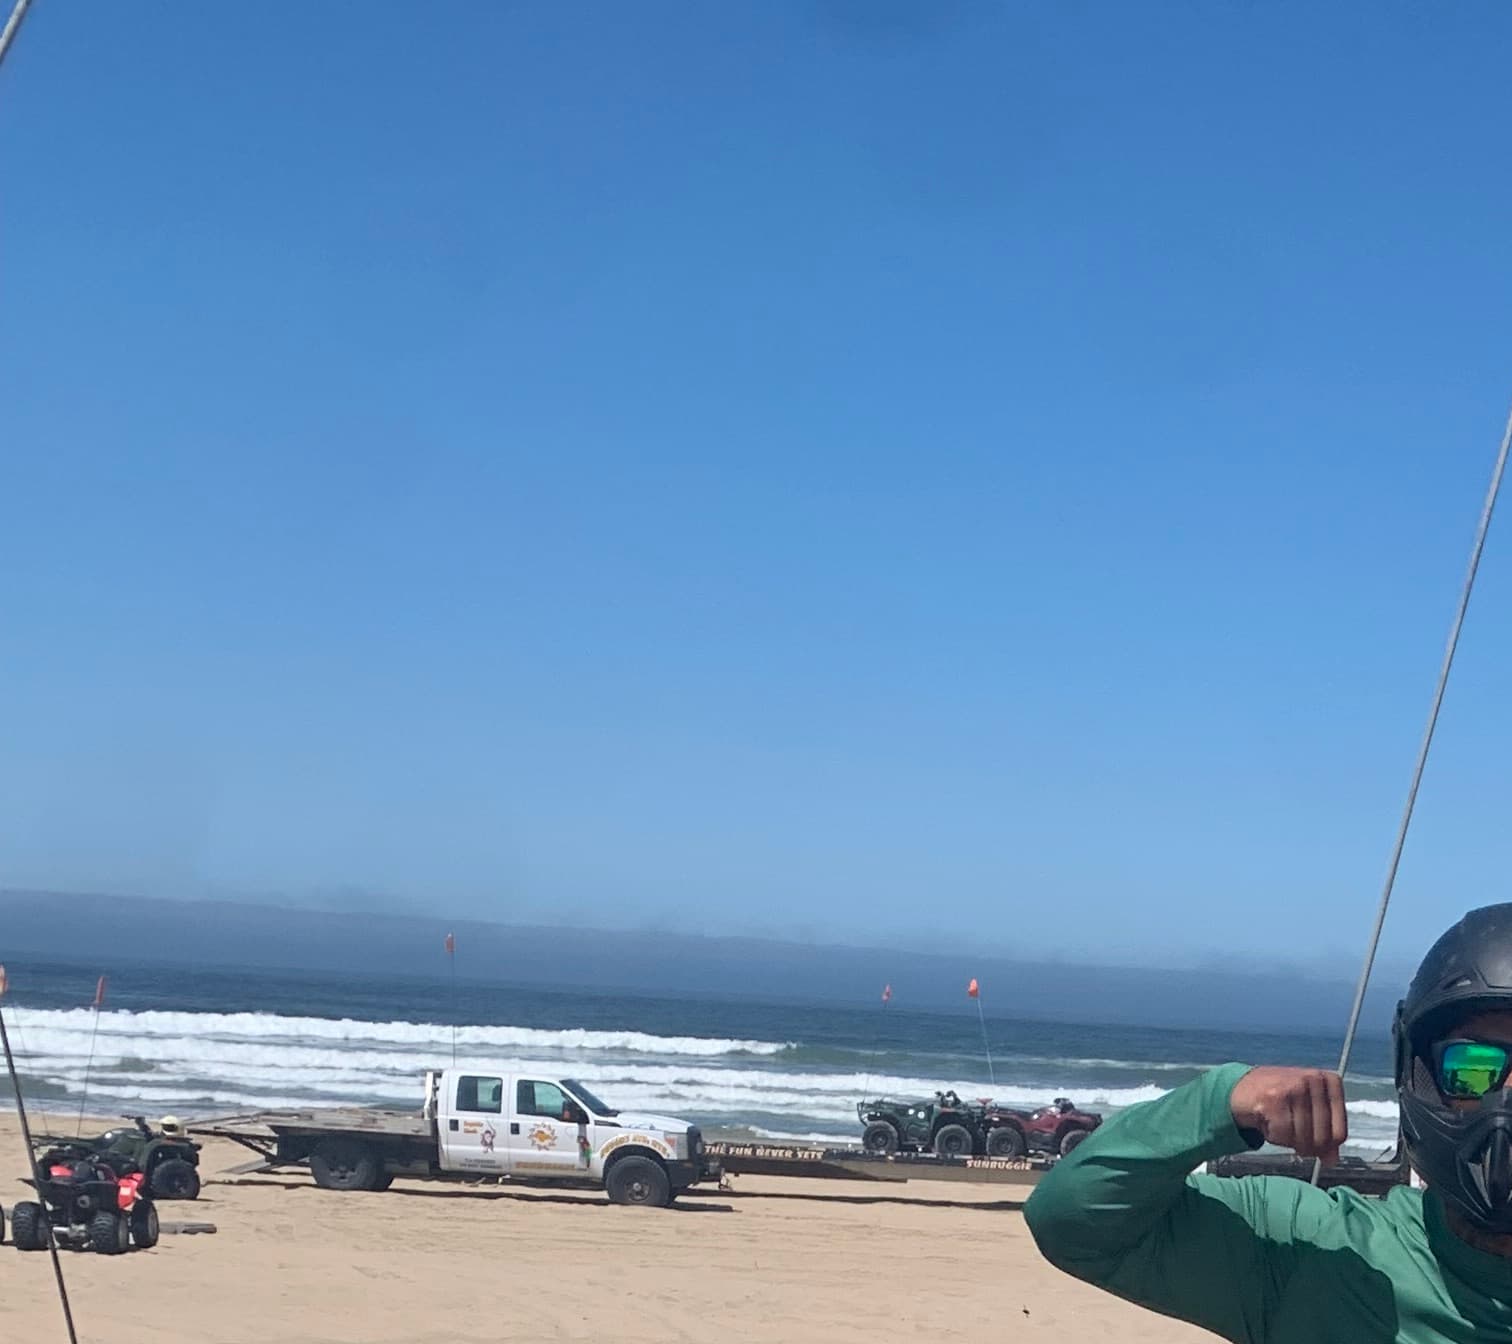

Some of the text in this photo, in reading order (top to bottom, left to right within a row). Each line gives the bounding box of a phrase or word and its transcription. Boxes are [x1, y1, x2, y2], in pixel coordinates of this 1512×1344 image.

[704, 1143, 726, 1155] THE
[728, 1145, 753, 1156] FUN
[755, 1146, 793, 1158] NEVER
